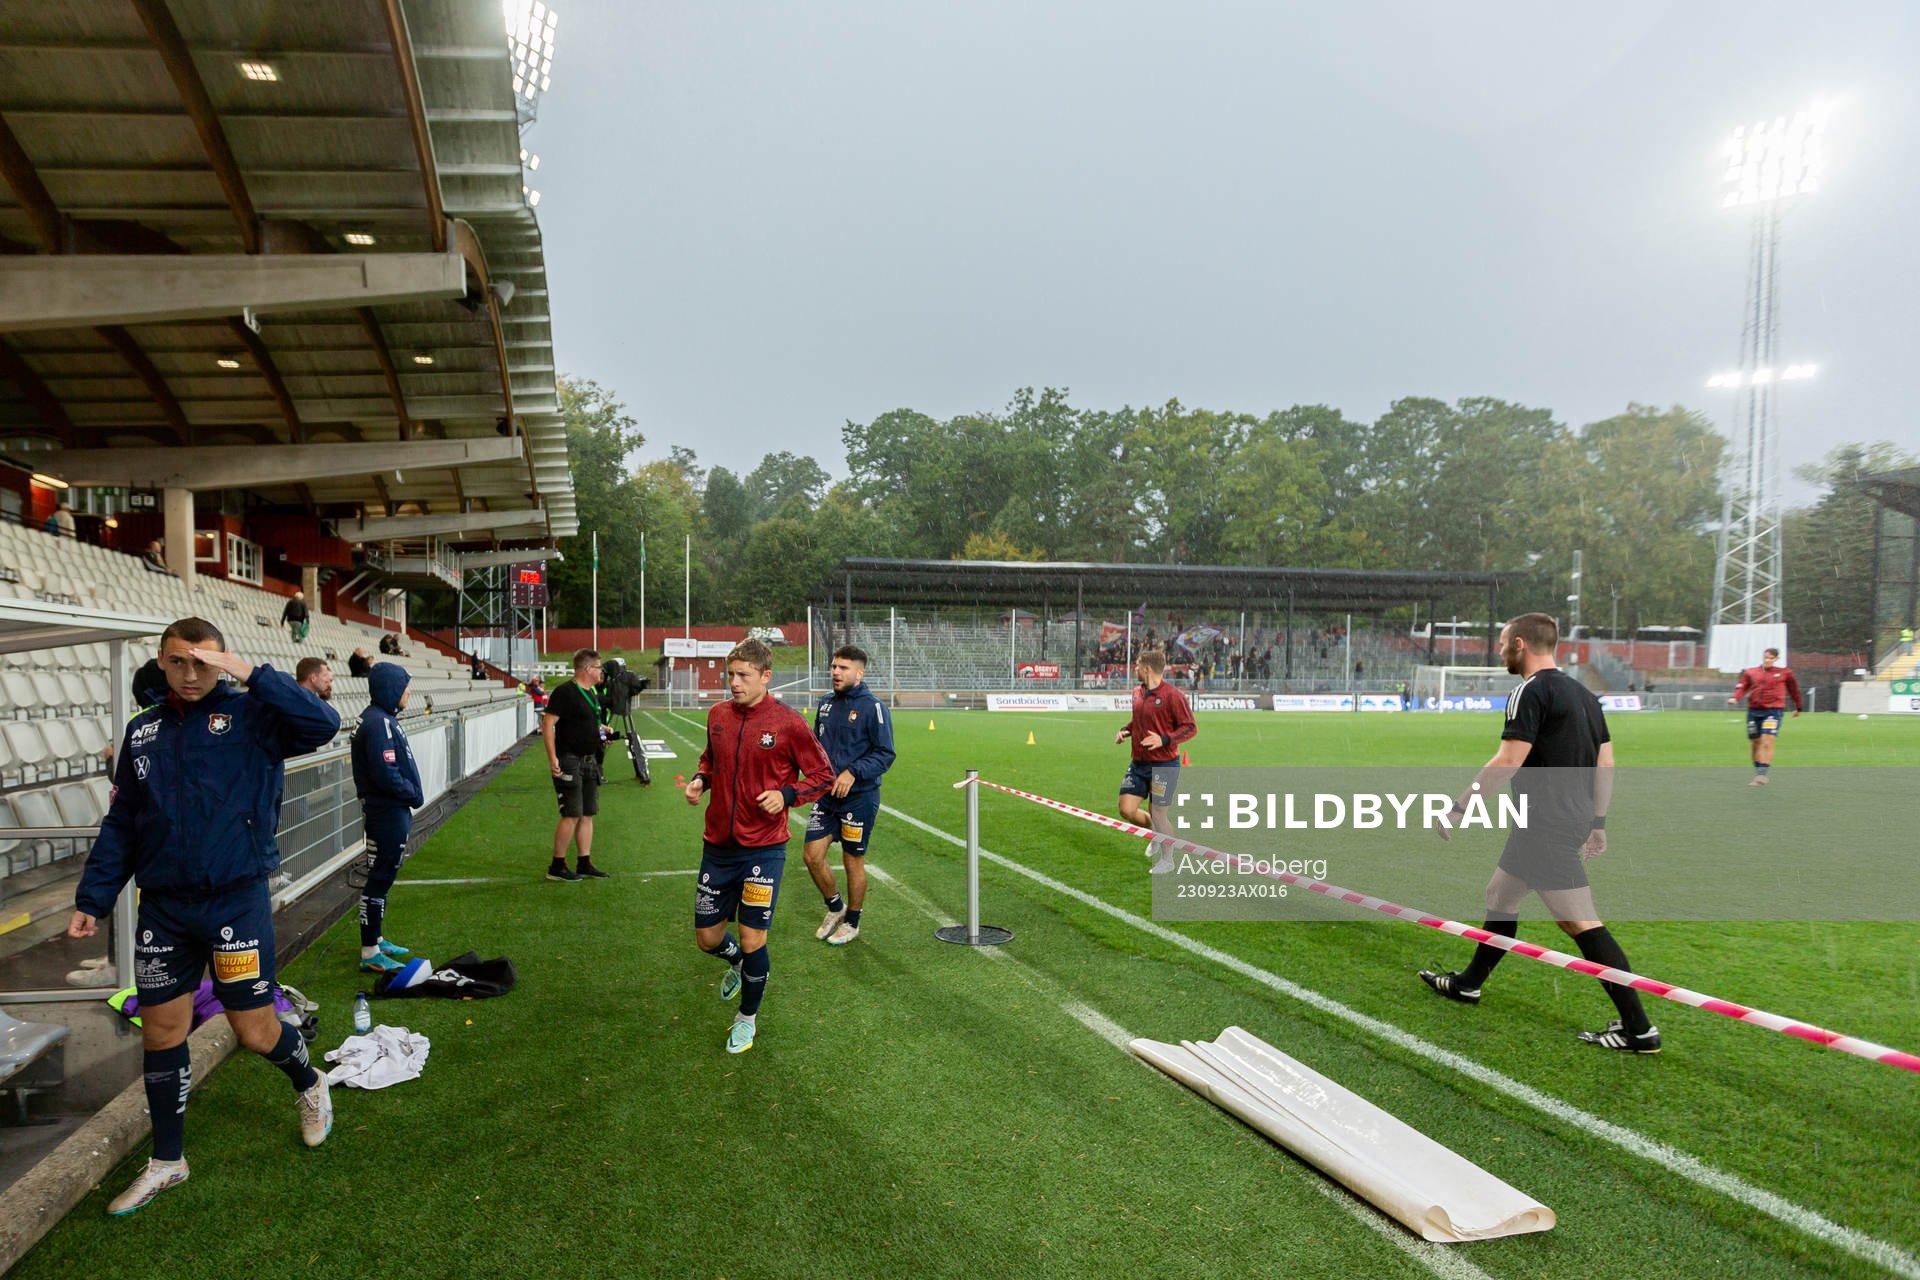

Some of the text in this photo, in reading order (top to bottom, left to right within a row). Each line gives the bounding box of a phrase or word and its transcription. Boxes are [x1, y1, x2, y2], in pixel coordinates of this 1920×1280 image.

[996, 696, 1060, 705] Sandbäckens
[214, 939, 259, 951] rinfo.se
[216, 954, 255, 966] TRIUMF
